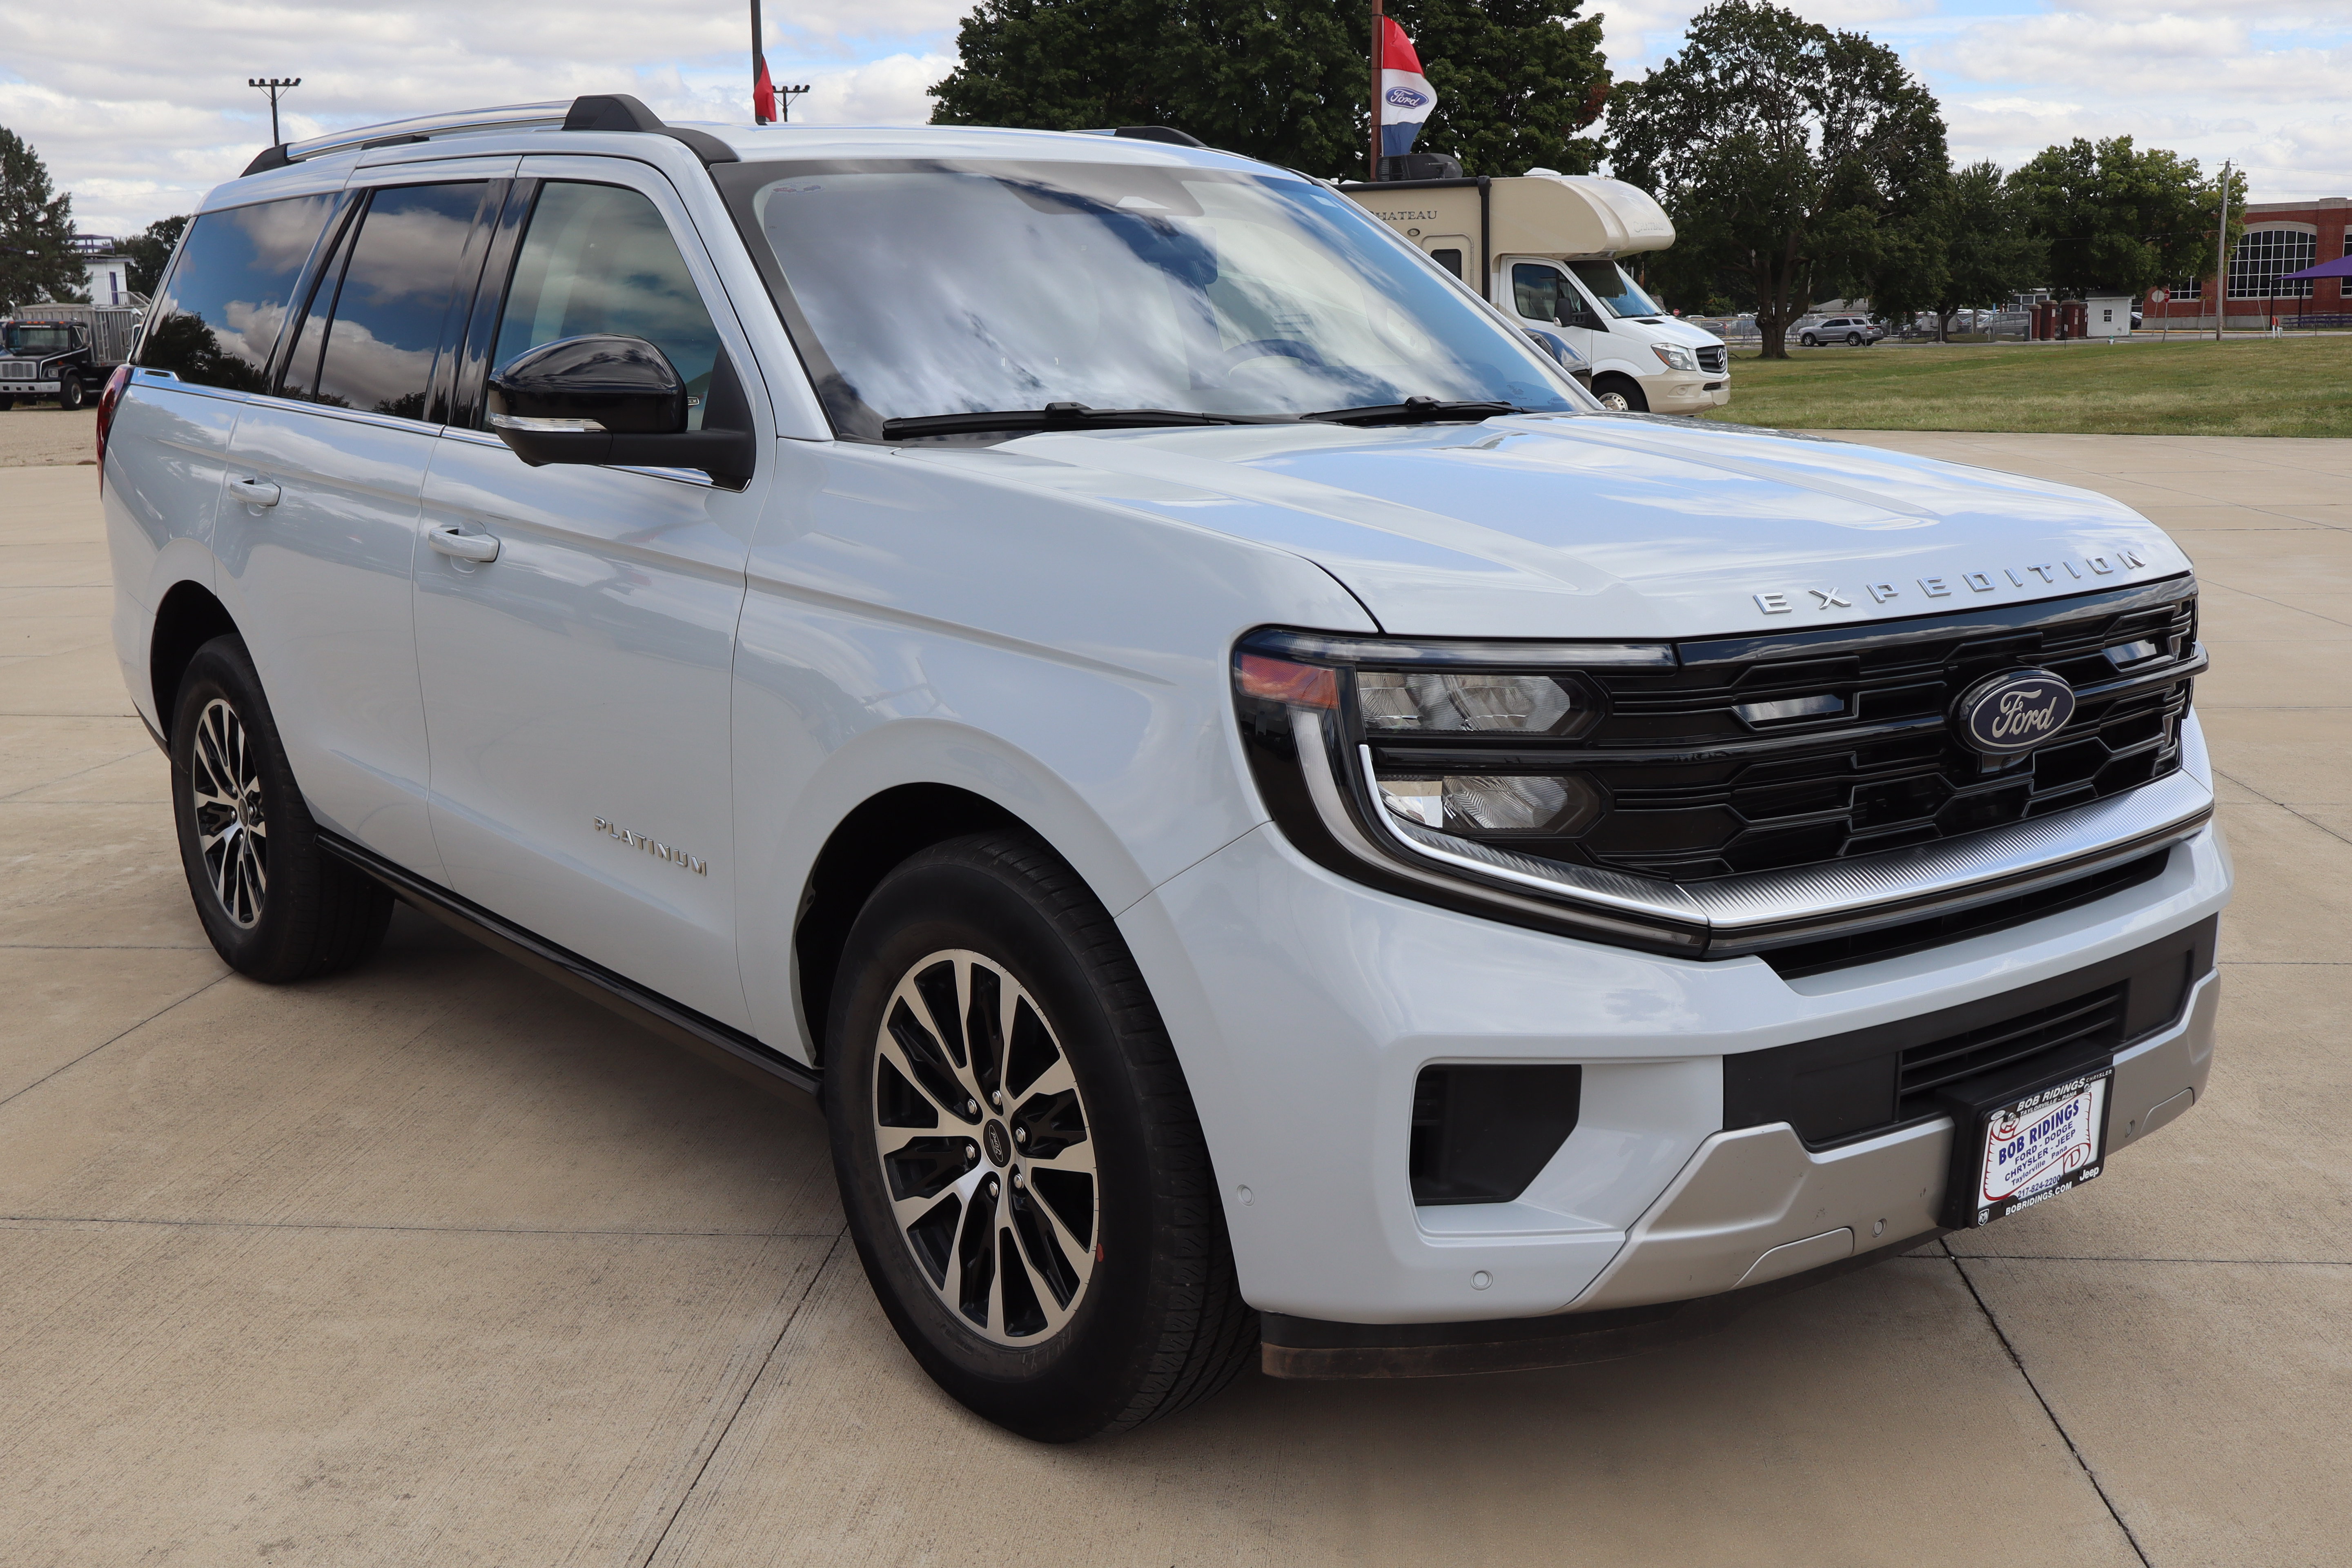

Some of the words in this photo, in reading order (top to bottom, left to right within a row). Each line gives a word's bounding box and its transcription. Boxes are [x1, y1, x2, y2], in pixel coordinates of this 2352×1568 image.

[1390, 89, 1420, 106] Ford
[1369, 211, 1437, 220] HATEAU
[1753, 549, 2146, 614] EXPEDITION
[1992, 689, 2057, 738] Ford
[594, 816, 706, 876] PLATINUM
[2086, 1069, 2112, 1082] CHRYSLER
[2016, 1095, 2040, 1112] BOB
[2042, 1078, 2085, 1102] RIDINGS
[2020, 1098, 2057, 1116] TAYLORVILLE
[2062, 1091, 2077, 1100] PANA
[991, 1131, 1001, 1155] Ford
[1999, 1136, 2024, 1166] BOB
[2029, 1099, 2079, 1145] RIDINGS
[2015, 1145, 2037, 1165] FORD
[2045, 1121, 2073, 1145] DODGE
[2005, 1147, 2048, 1181] CHRYSLER
[2056, 1129, 2076, 1147] JEEP
[2011, 1160, 2045, 1186] Taylorville
[2051, 1145, 2067, 1159] Pana
[2018, 1174, 2061, 1198] 217-824-2200
[2079, 1167, 2099, 1181] Jeep
[2005, 1181, 2072, 1216] BOBRIDINGS.COM
